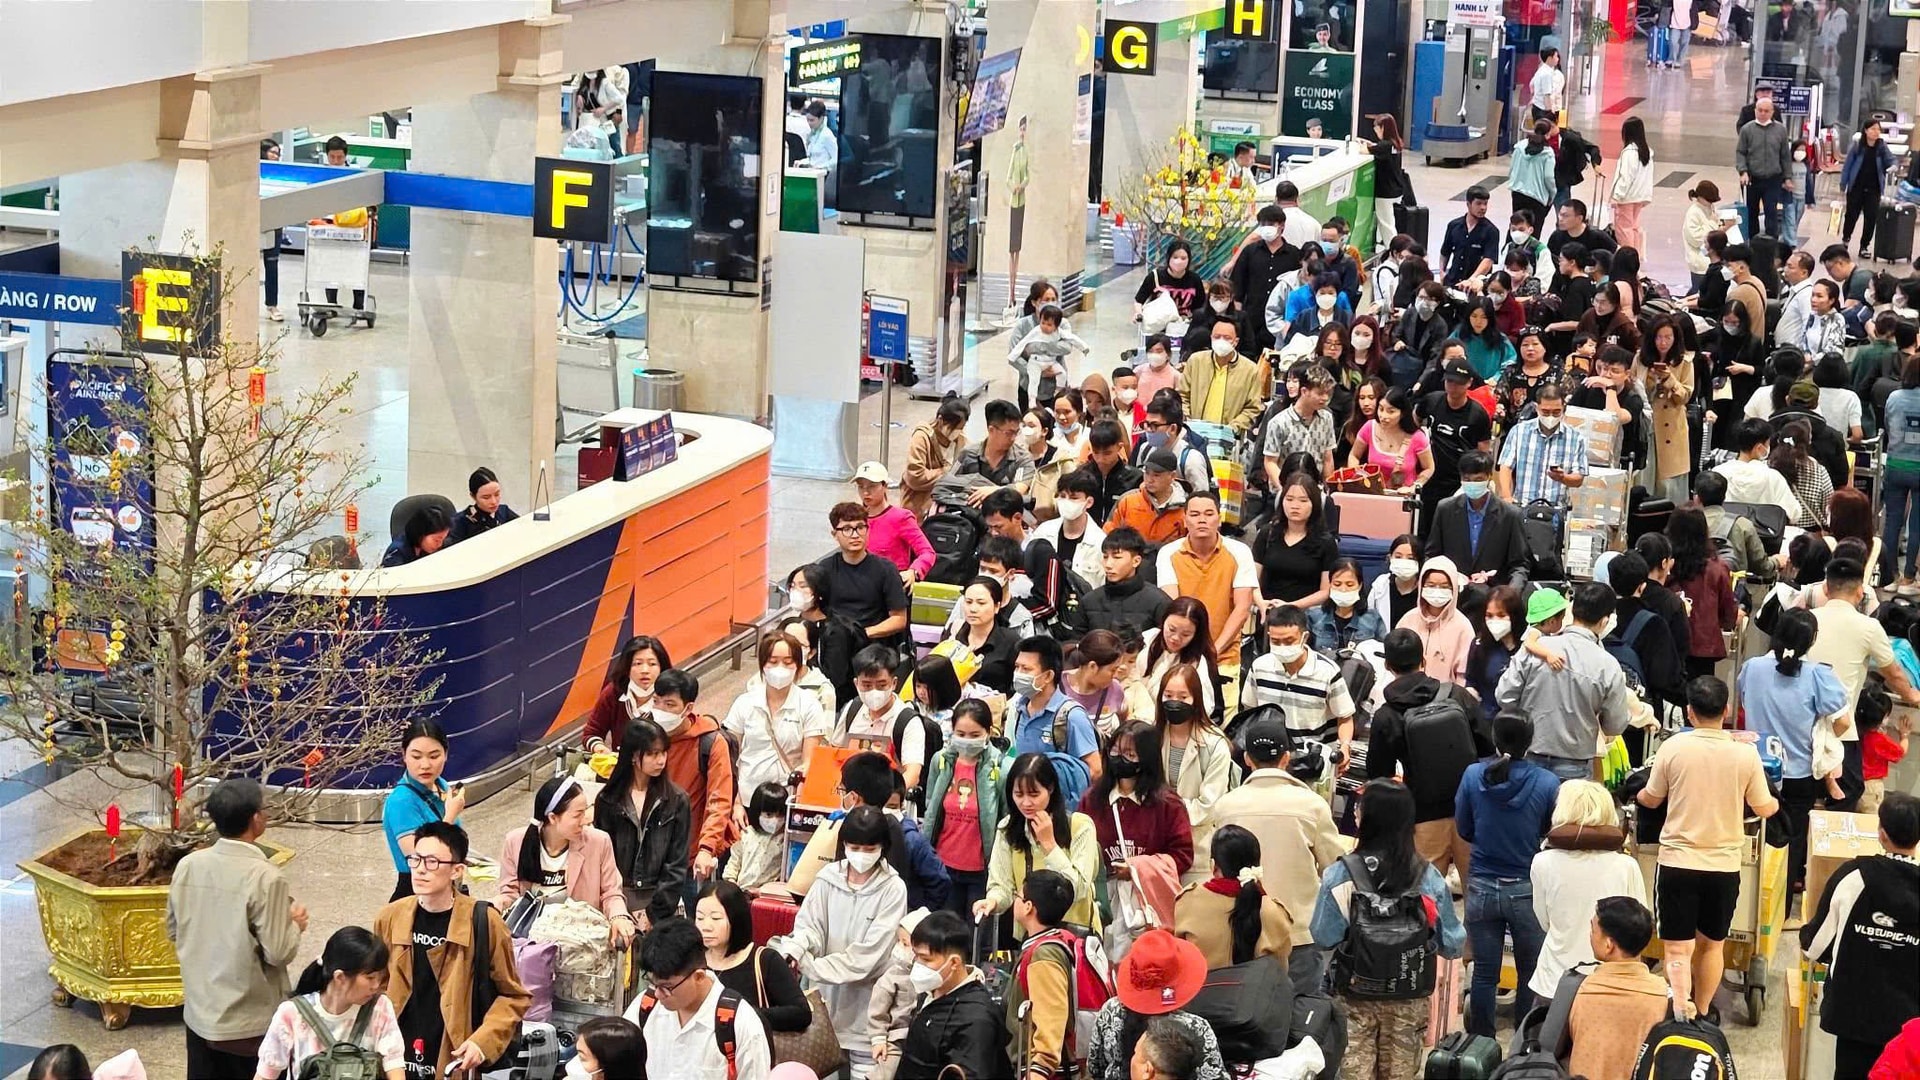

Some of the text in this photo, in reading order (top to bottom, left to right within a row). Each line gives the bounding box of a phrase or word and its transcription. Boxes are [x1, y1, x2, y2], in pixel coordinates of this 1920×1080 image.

[1232, 0, 1265, 37] H
[1111, 26, 1149, 69] G
[1294, 86, 1343, 99] ECONOMY
[1301, 98, 1334, 111] CLASS
[551, 169, 593, 229] F
[54, 294, 97, 313] ROW
[142, 267, 192, 343] E
[75, 389, 122, 400] AIRLINES
[84, 463, 100, 473] NO
